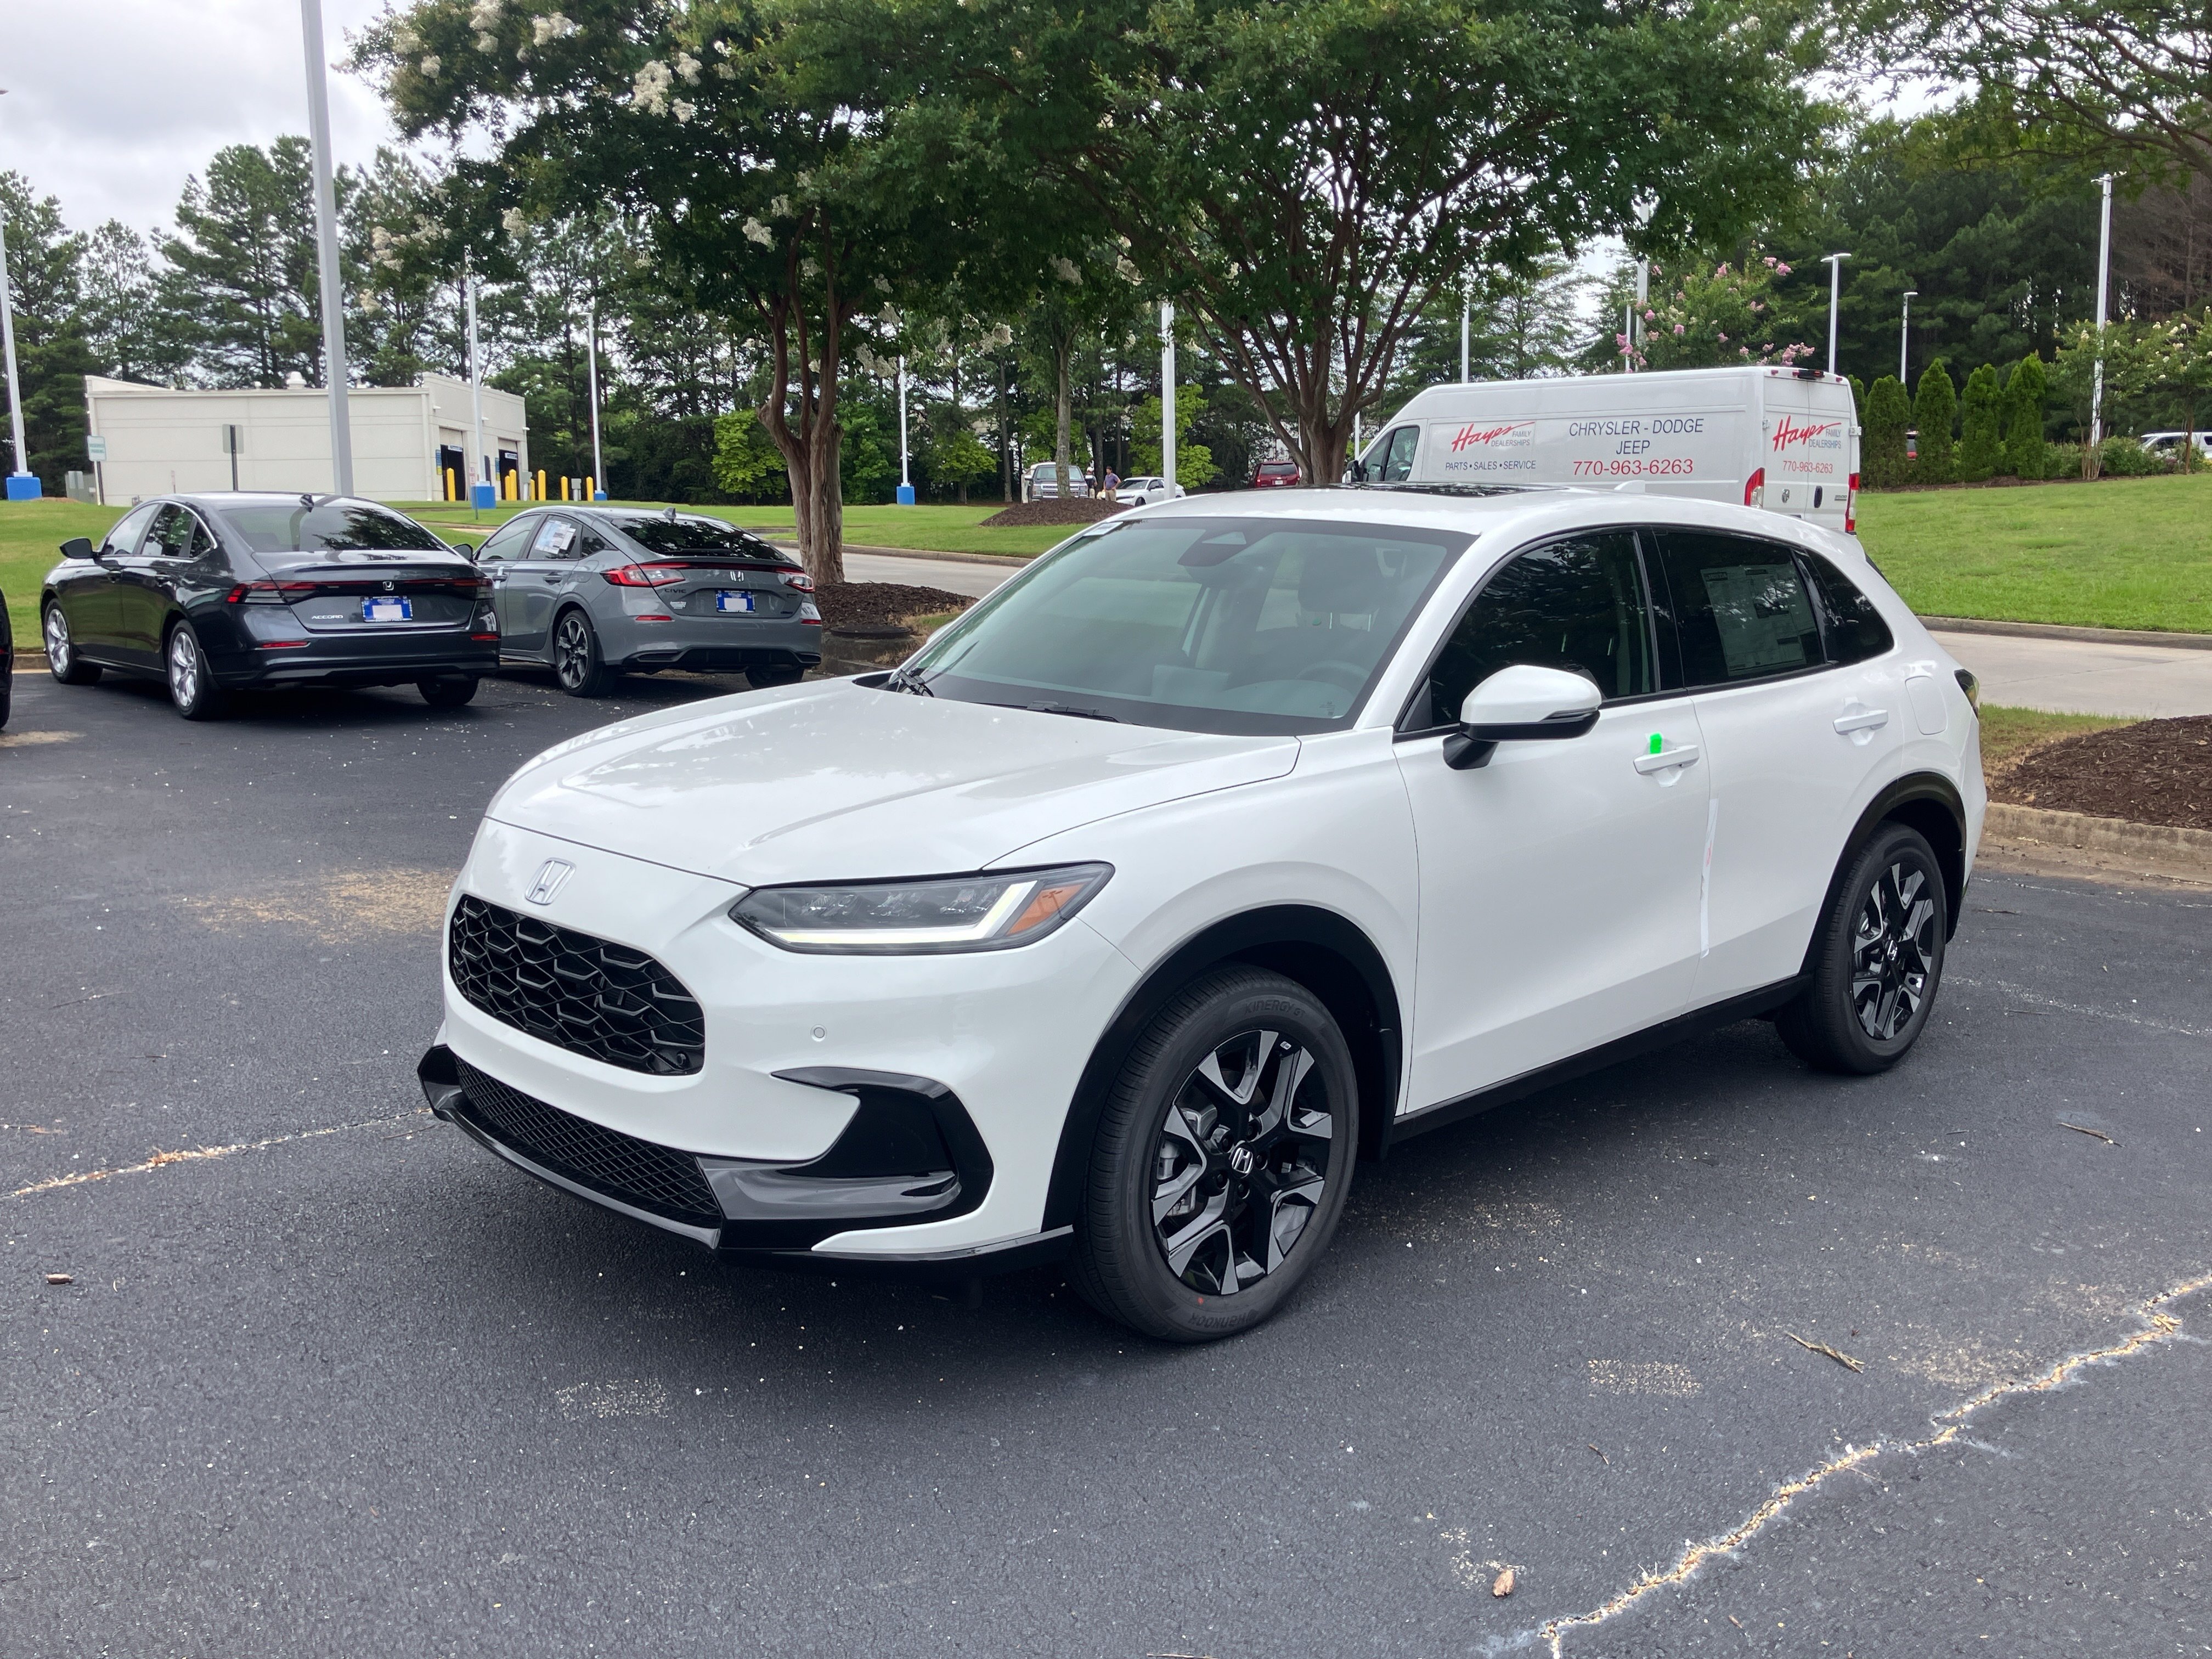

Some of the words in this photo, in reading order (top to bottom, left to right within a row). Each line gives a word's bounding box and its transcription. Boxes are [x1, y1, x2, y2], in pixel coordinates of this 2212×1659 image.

[1569, 420, 1640, 436] CHRYSLER
[1652, 419, 1704, 434] DODGE
[1773, 414, 1842, 453] Hayes
[1825, 428, 1842, 437] FAMILY
[1451, 422, 1535, 453] Hayes
[1809, 439, 1842, 449] DEALERSHIPS
[1616, 440, 1650, 454] JEEP
[1445, 462, 1468, 471] PARTS
[1474, 461, 1497, 470] SALES
[1503, 460, 1536, 470] SERVICE
[1573, 459, 1694, 476] 770-963-6263
[1783, 460, 1833, 474] 770-963-6263
[1244, 999, 1295, 1015] KINERGY
